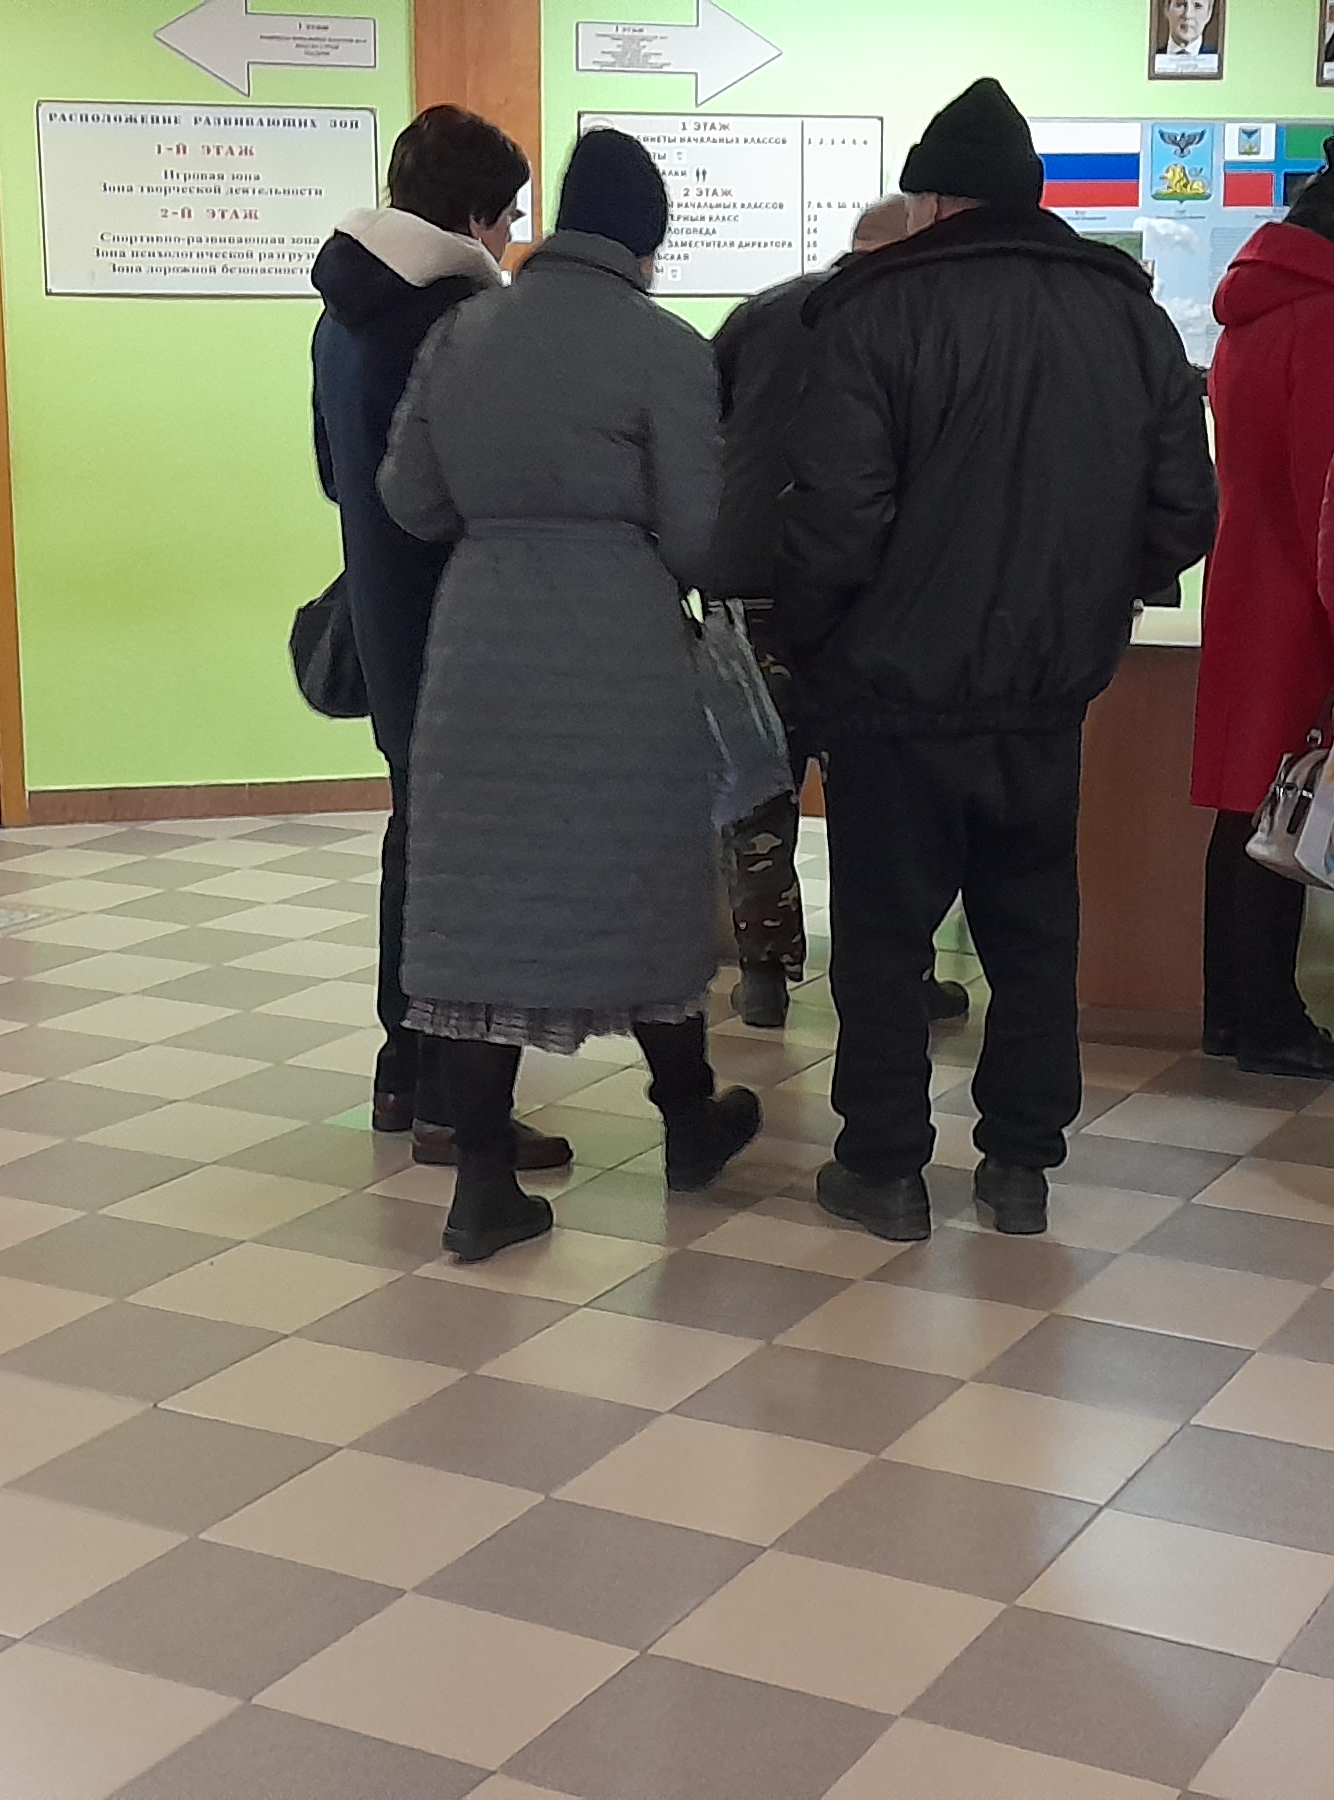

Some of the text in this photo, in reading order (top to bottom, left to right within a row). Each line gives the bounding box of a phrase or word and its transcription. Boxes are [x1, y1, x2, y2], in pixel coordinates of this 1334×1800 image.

[48, 112, 360, 130] РАСПОЛОЖЕНИЕ РАЗВИВАЮЩИХ ЗОН
[693, 121, 731, 132] ЭТАЖ
[201, 144, 255, 157] ЭТАЖ
[163, 169, 261, 183] Игровая зона
[102, 182, 323, 197] Зона творческой деятельности
[695, 187, 734, 198] ЭТАЖ
[206, 208, 259, 220] ЭТАЖ
[291, 236, 320, 245] зона
[94, 247, 126, 259] Зона
[131, 249, 254, 260] психологической
[110, 262, 142, 273] Зона
[147, 264, 217, 276] дорожной
